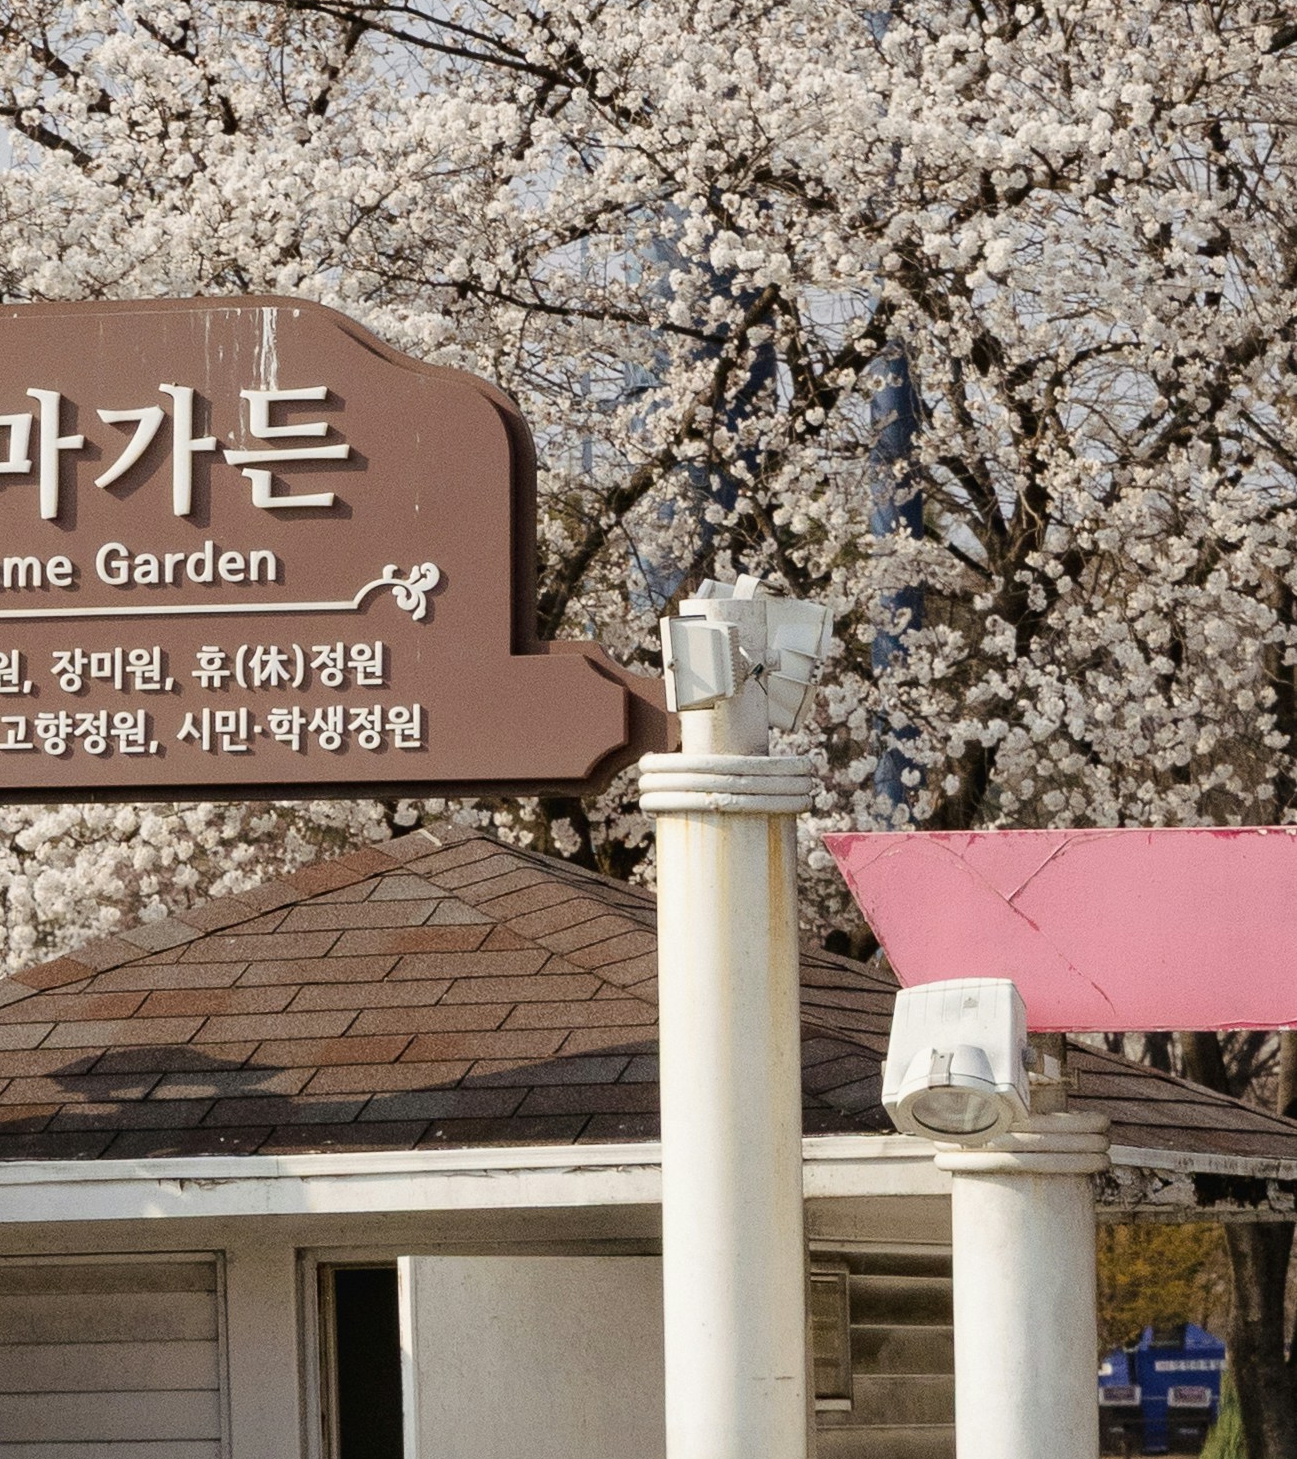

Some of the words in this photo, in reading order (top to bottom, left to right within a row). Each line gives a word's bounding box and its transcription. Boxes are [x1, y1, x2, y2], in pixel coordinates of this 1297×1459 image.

[95, 540, 277, 586] Garden
[51, 646, 174, 693] 장미원,
[191, 641, 383, 689] 휴(休)정원
[176, 703, 422, 752] 시민·학생정원
